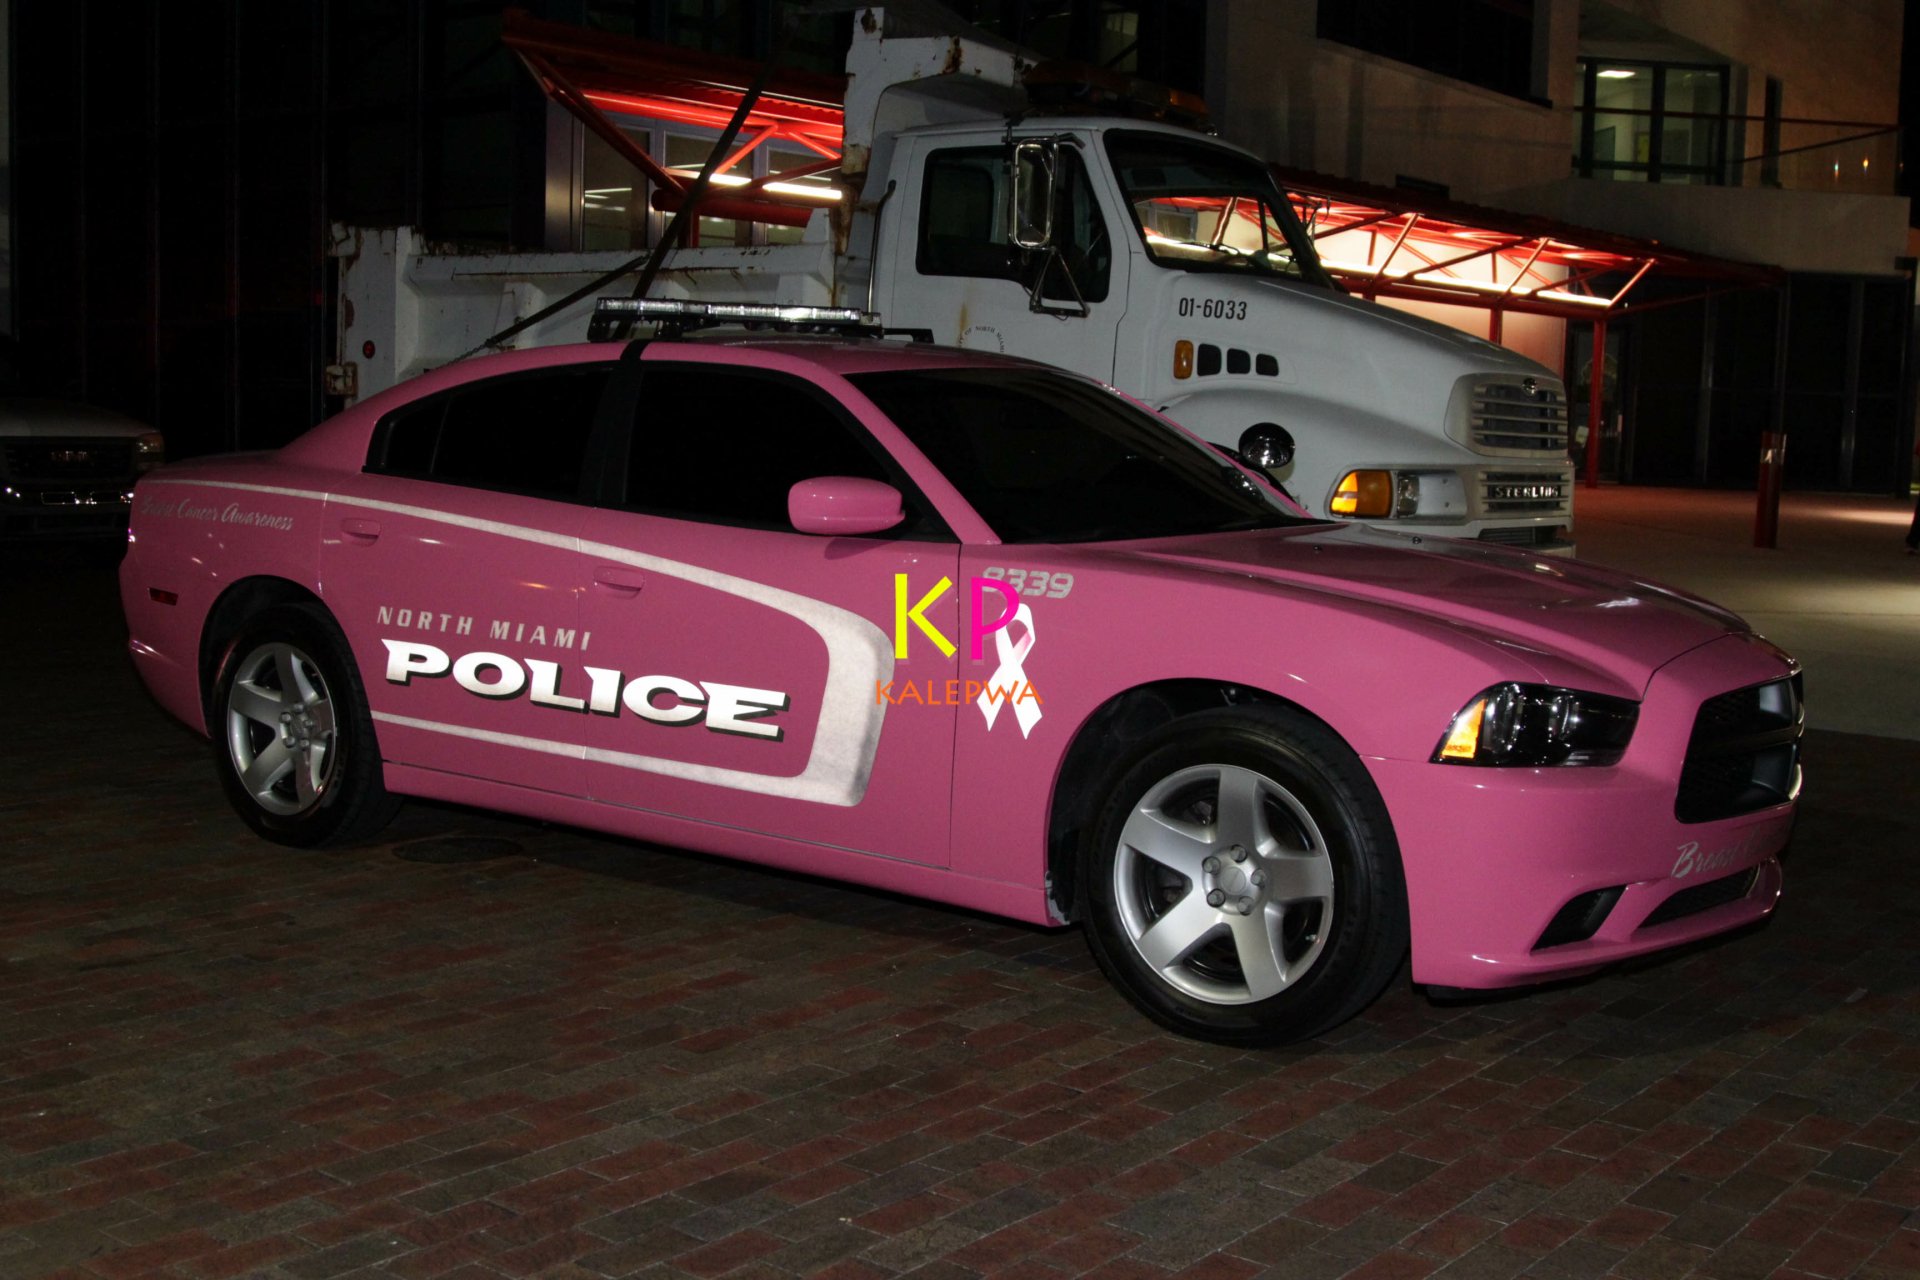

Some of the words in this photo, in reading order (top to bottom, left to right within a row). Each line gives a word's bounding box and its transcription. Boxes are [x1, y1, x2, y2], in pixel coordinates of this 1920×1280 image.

[1179, 297, 1248, 321] 01-6033
[177, 498, 219, 521] Cancer
[221, 502, 295, 532] Awareness
[377, 605, 474, 636] NORTH
[489, 618, 592, 651] MIAMI
[380, 638, 790, 742] POLICE
